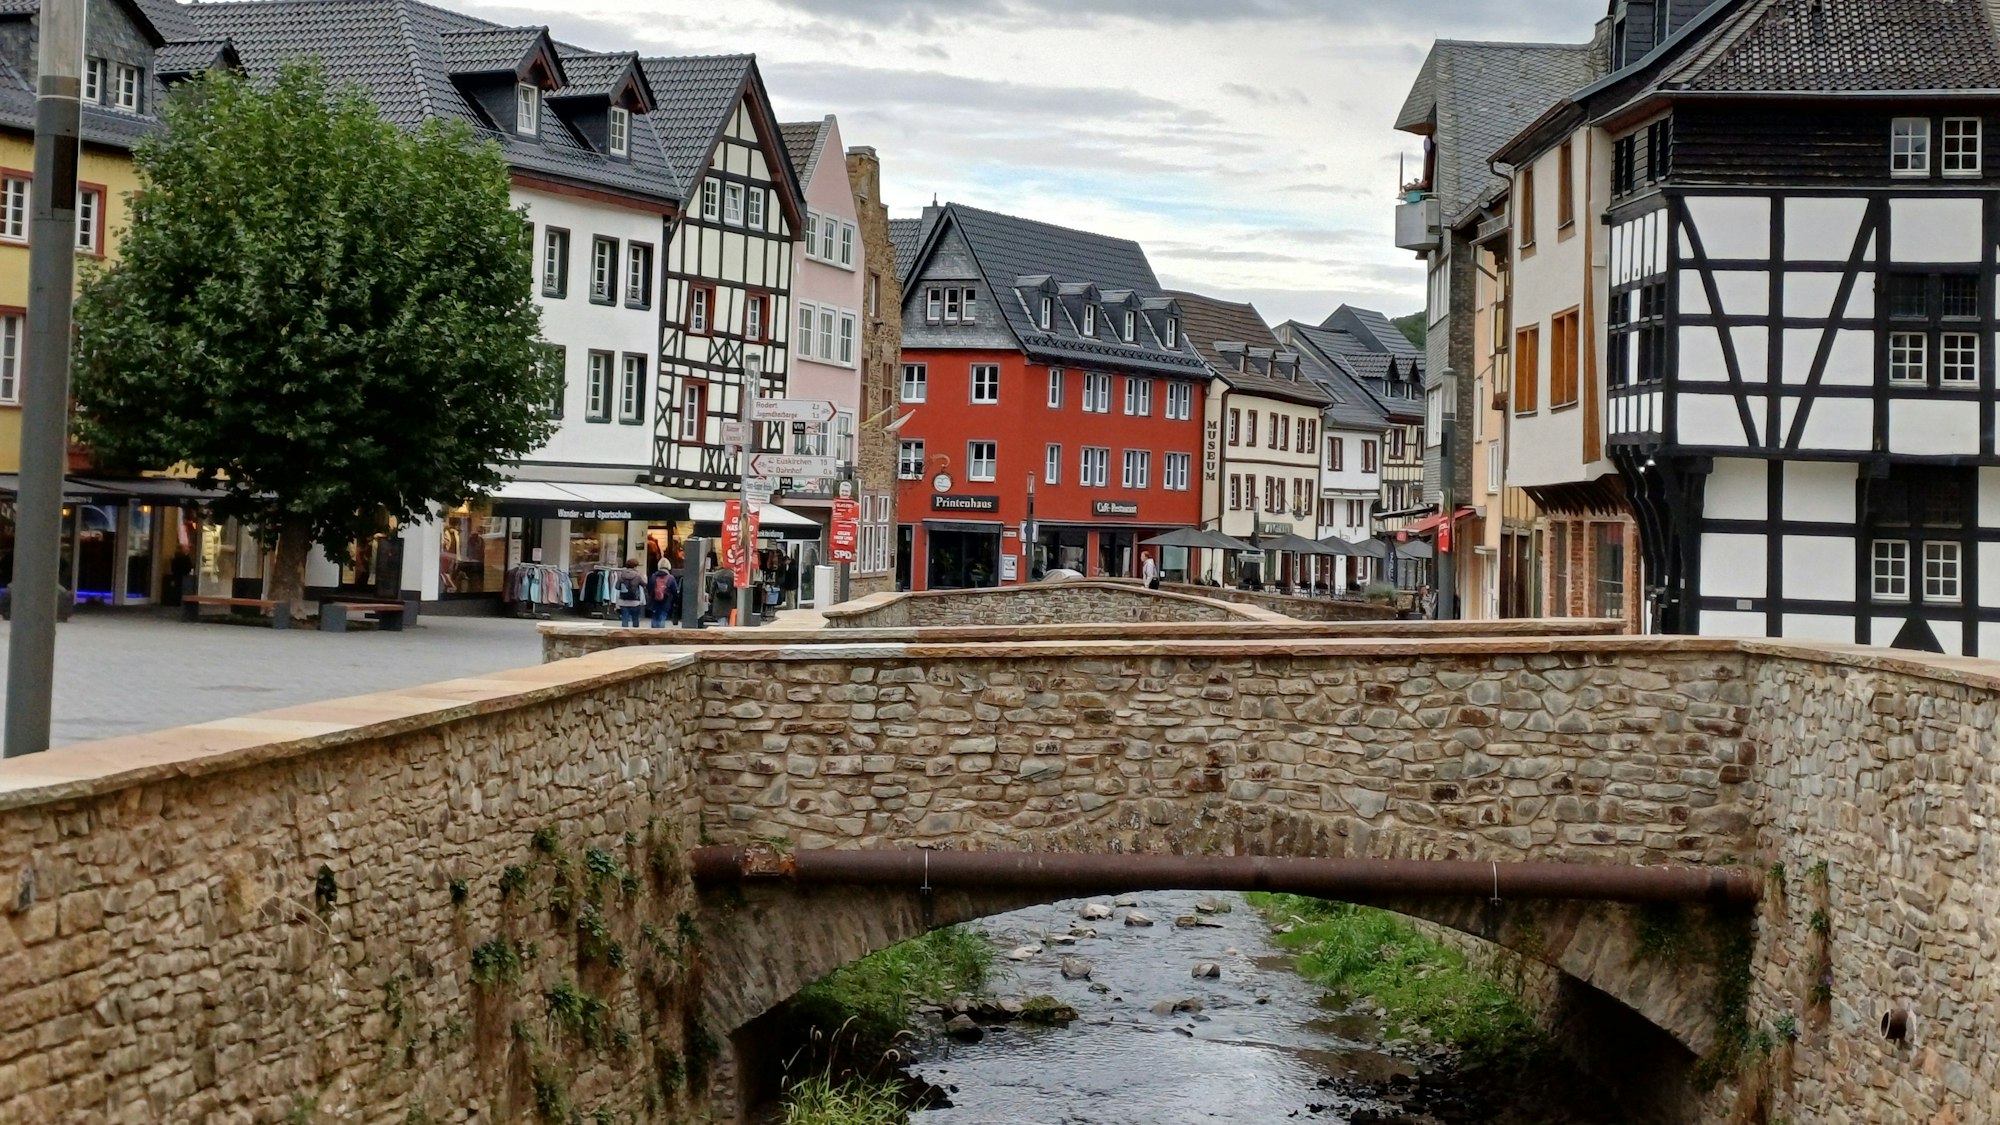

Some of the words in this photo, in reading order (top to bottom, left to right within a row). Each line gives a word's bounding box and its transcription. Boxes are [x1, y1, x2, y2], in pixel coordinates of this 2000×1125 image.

[1205, 421, 1218, 480] MUSEUM
[776, 457, 812, 465] Euskirchen
[935, 496, 993, 509] Printenhaus
[584, 510, 595, 518] und
[833, 549, 853, 560] SPD
